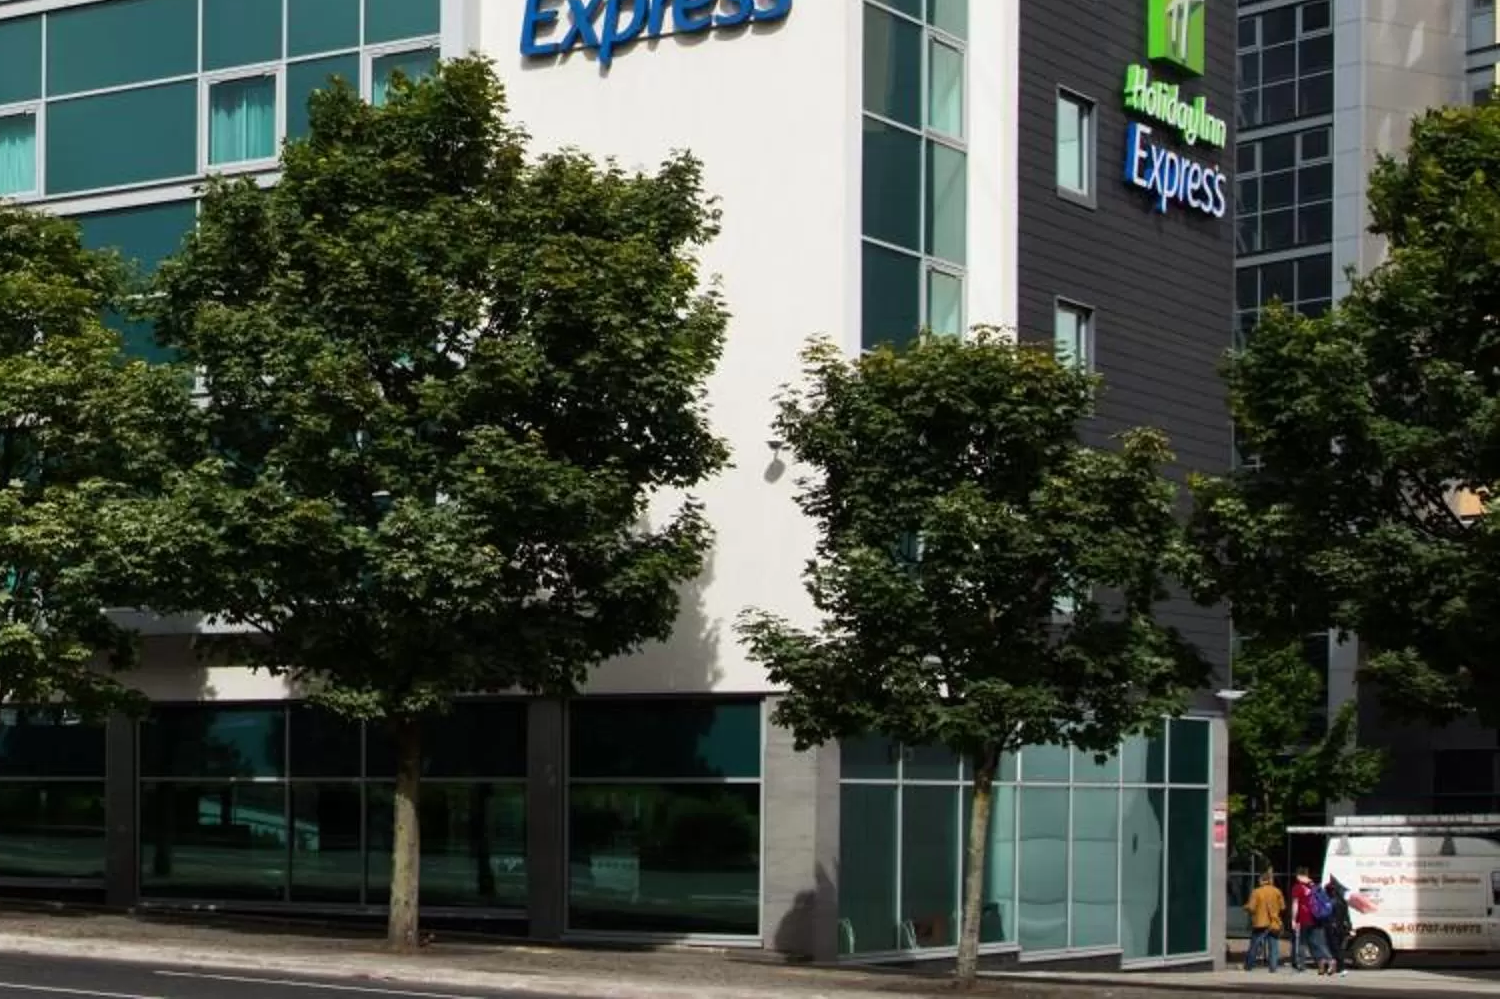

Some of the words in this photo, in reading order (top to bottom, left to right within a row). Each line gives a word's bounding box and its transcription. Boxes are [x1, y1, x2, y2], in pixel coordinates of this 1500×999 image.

[1124, 64, 1199, 145] Holiday
[1198, 97, 1226, 149] Inn
[1126, 121, 1227, 218] Express
